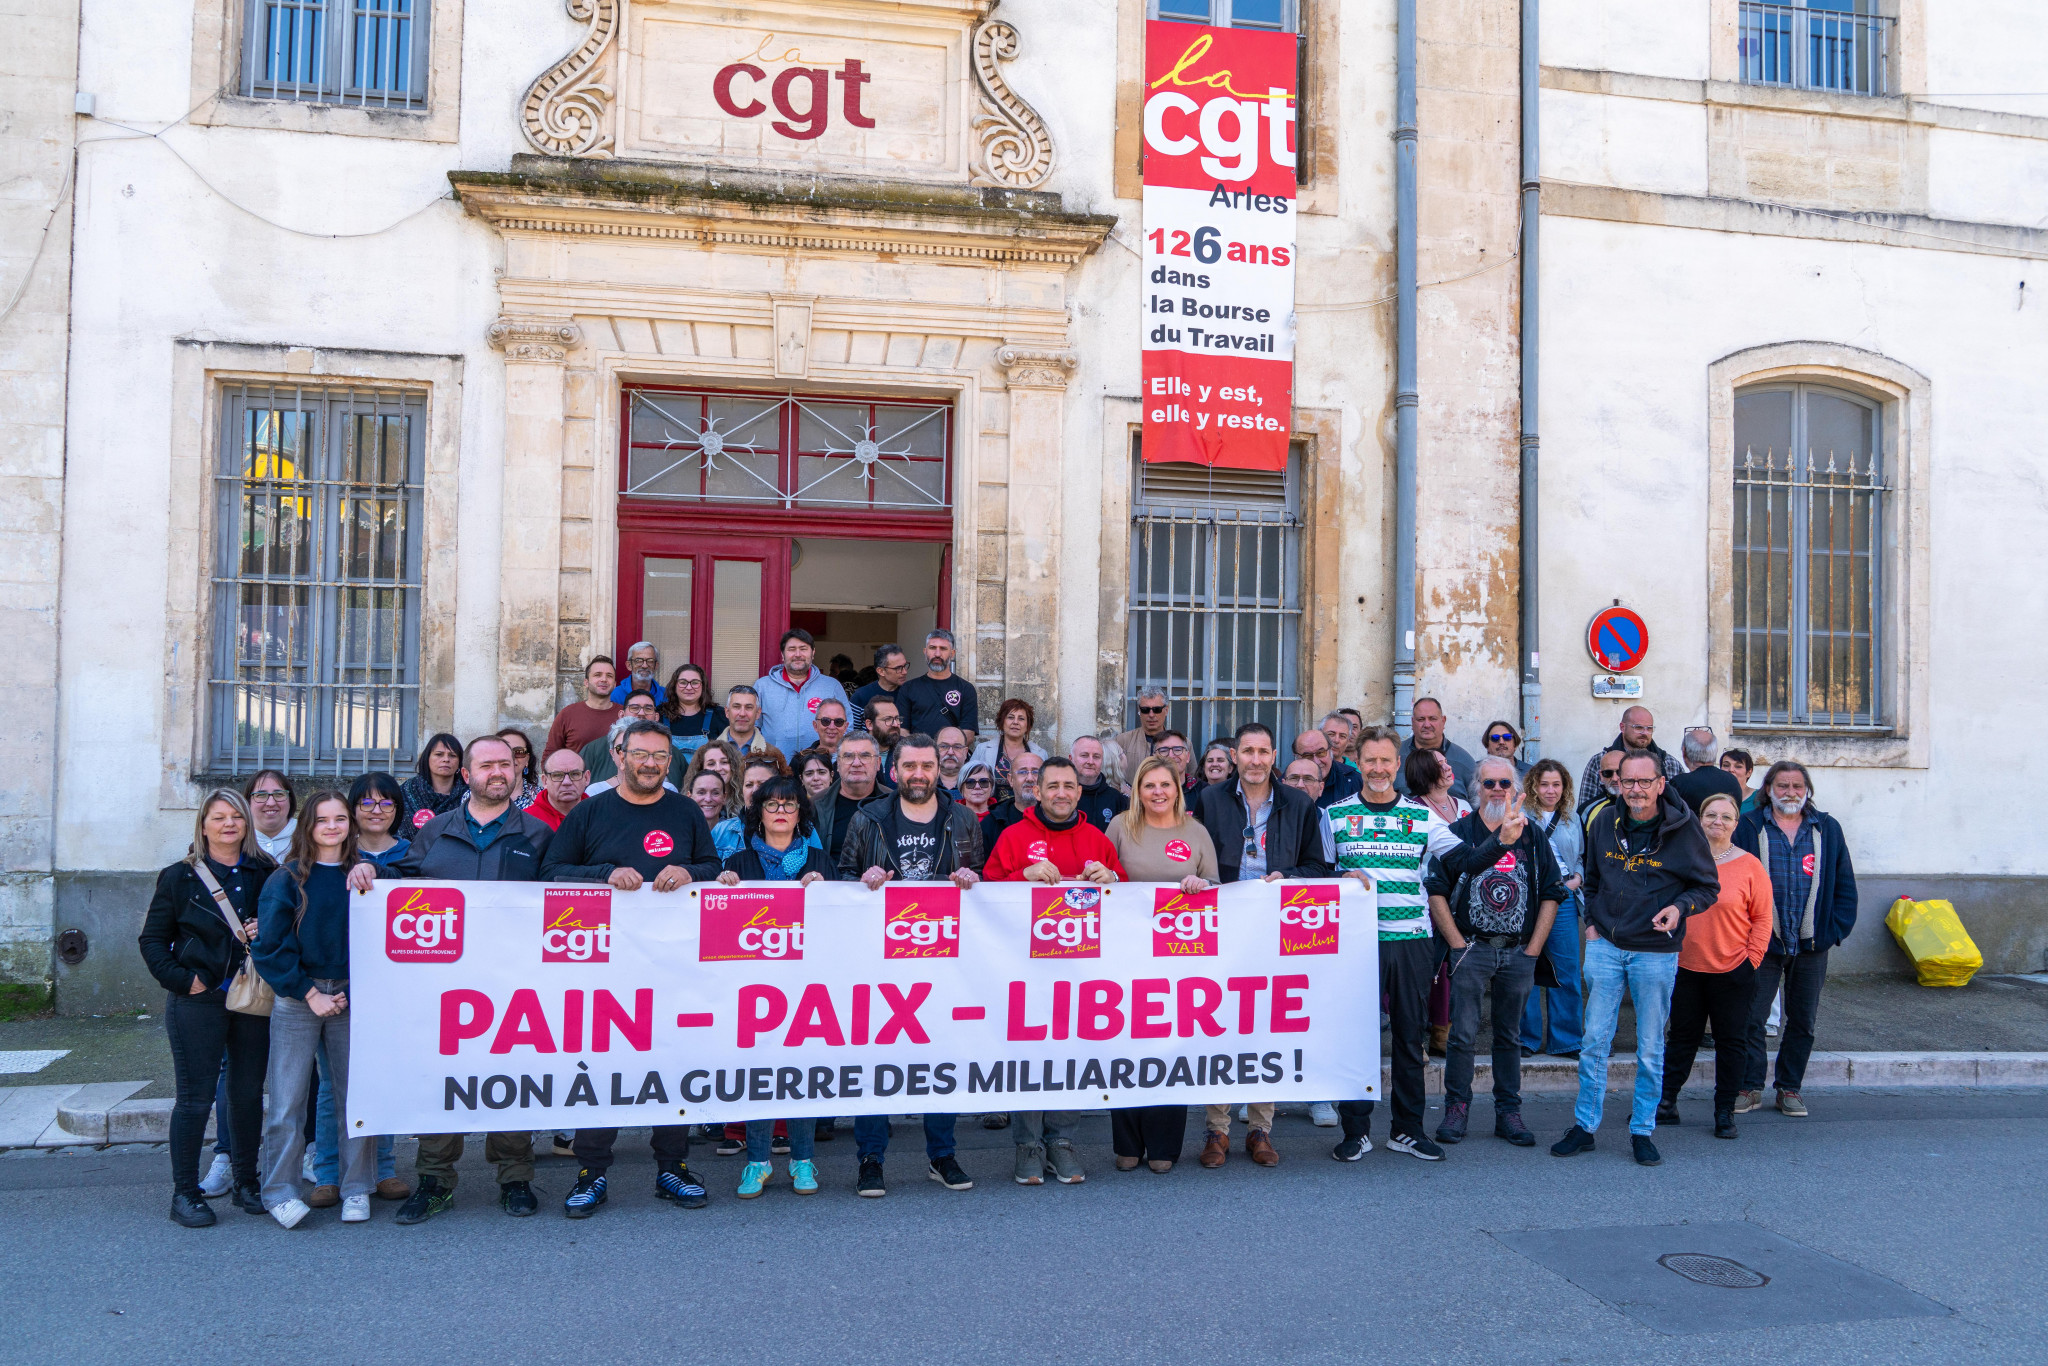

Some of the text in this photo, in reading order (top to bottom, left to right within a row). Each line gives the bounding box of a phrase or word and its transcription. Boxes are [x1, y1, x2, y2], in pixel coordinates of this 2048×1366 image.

[737, 33, 865, 64] la
[1151, 34, 1296, 98] la
[713, 58, 875, 140] cgt
[1144, 87, 1296, 182] cgt
[1209, 183, 1288, 214] Arles
[1227, 241, 1290, 267] ans
[1151, 265, 1210, 289] dans
[1151, 295, 1270, 323] la Bourse
[1150, 324, 1274, 352] du Travail
[1151, 377, 1263, 406] Elle y est,
[1151, 404, 1285, 432] elle y reste.
[396, 889, 458, 913] la
[704, 893, 728, 901] alpes
[1037, 897, 1098, 918] la
[1072, 892, 1092, 900] FSM
[1156, 894, 1217, 912] la
[1283, 888, 1340, 906] la
[546, 907, 611, 929] la
[742, 906, 804, 927] la
[889, 903, 959, 921] la
[1152, 905, 1219, 940] cgt
[1280, 901, 1340, 929] cgt
[392, 907, 458, 948] cgt
[542, 923, 611, 960] cgt
[738, 922, 804, 958] cgt
[885, 916, 957, 945] cgt
[1033, 911, 1099, 947] cgt
[892, 947, 950, 957] PACA
[1032, 948, 1062, 958] Bouches
[1077, 944, 1098, 952] Rhône
[1166, 942, 1205, 954] VAR
[1282, 932, 1335, 953] Vaucluse
[439, 988, 654, 1055] PAIN
[737, 982, 933, 1048] PAIX
[1007, 974, 1311, 1041] LIBERTE
[444, 1074, 553, 1111] NON
[564, 1060, 599, 1107] À
[610, 1071, 669, 1105] LA
[680, 1065, 863, 1103] GUERRE
[873, 1063, 957, 1096] DES
[968, 1051, 1284, 1092] MILLIARDAIRES
